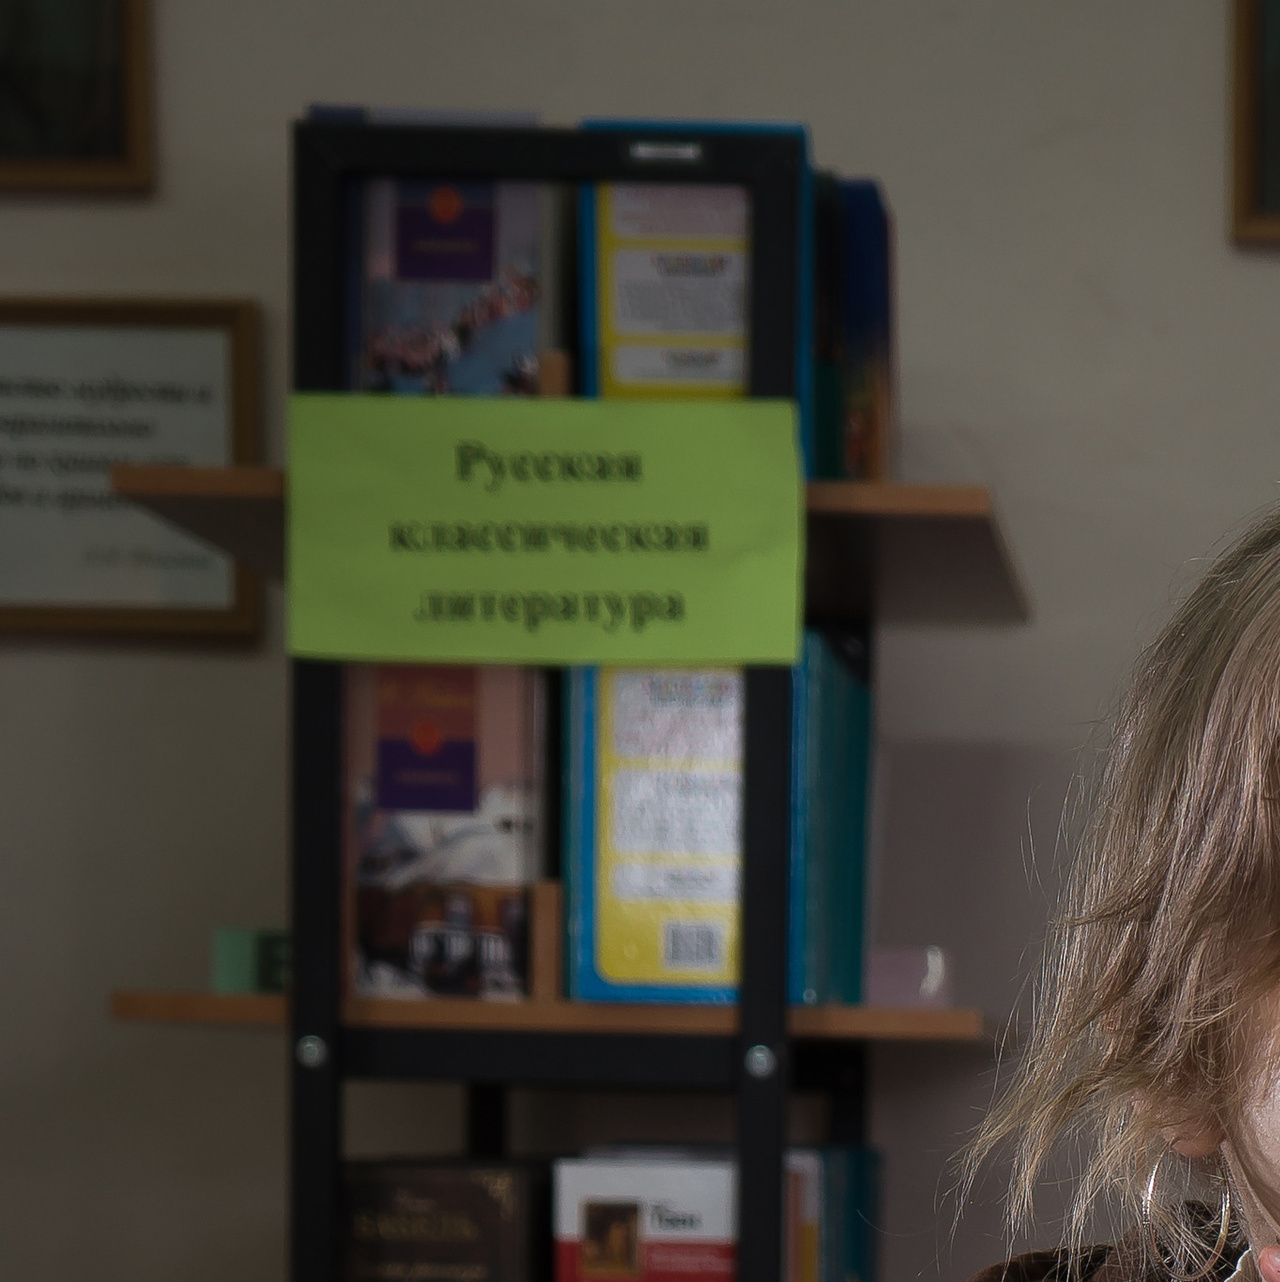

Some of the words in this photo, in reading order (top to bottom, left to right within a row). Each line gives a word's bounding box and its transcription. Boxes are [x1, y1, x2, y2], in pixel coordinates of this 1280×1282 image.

[454, 439, 644, 492] Русская
[388, 520, 710, 553] классическая
[413, 591, 686, 634] литература
